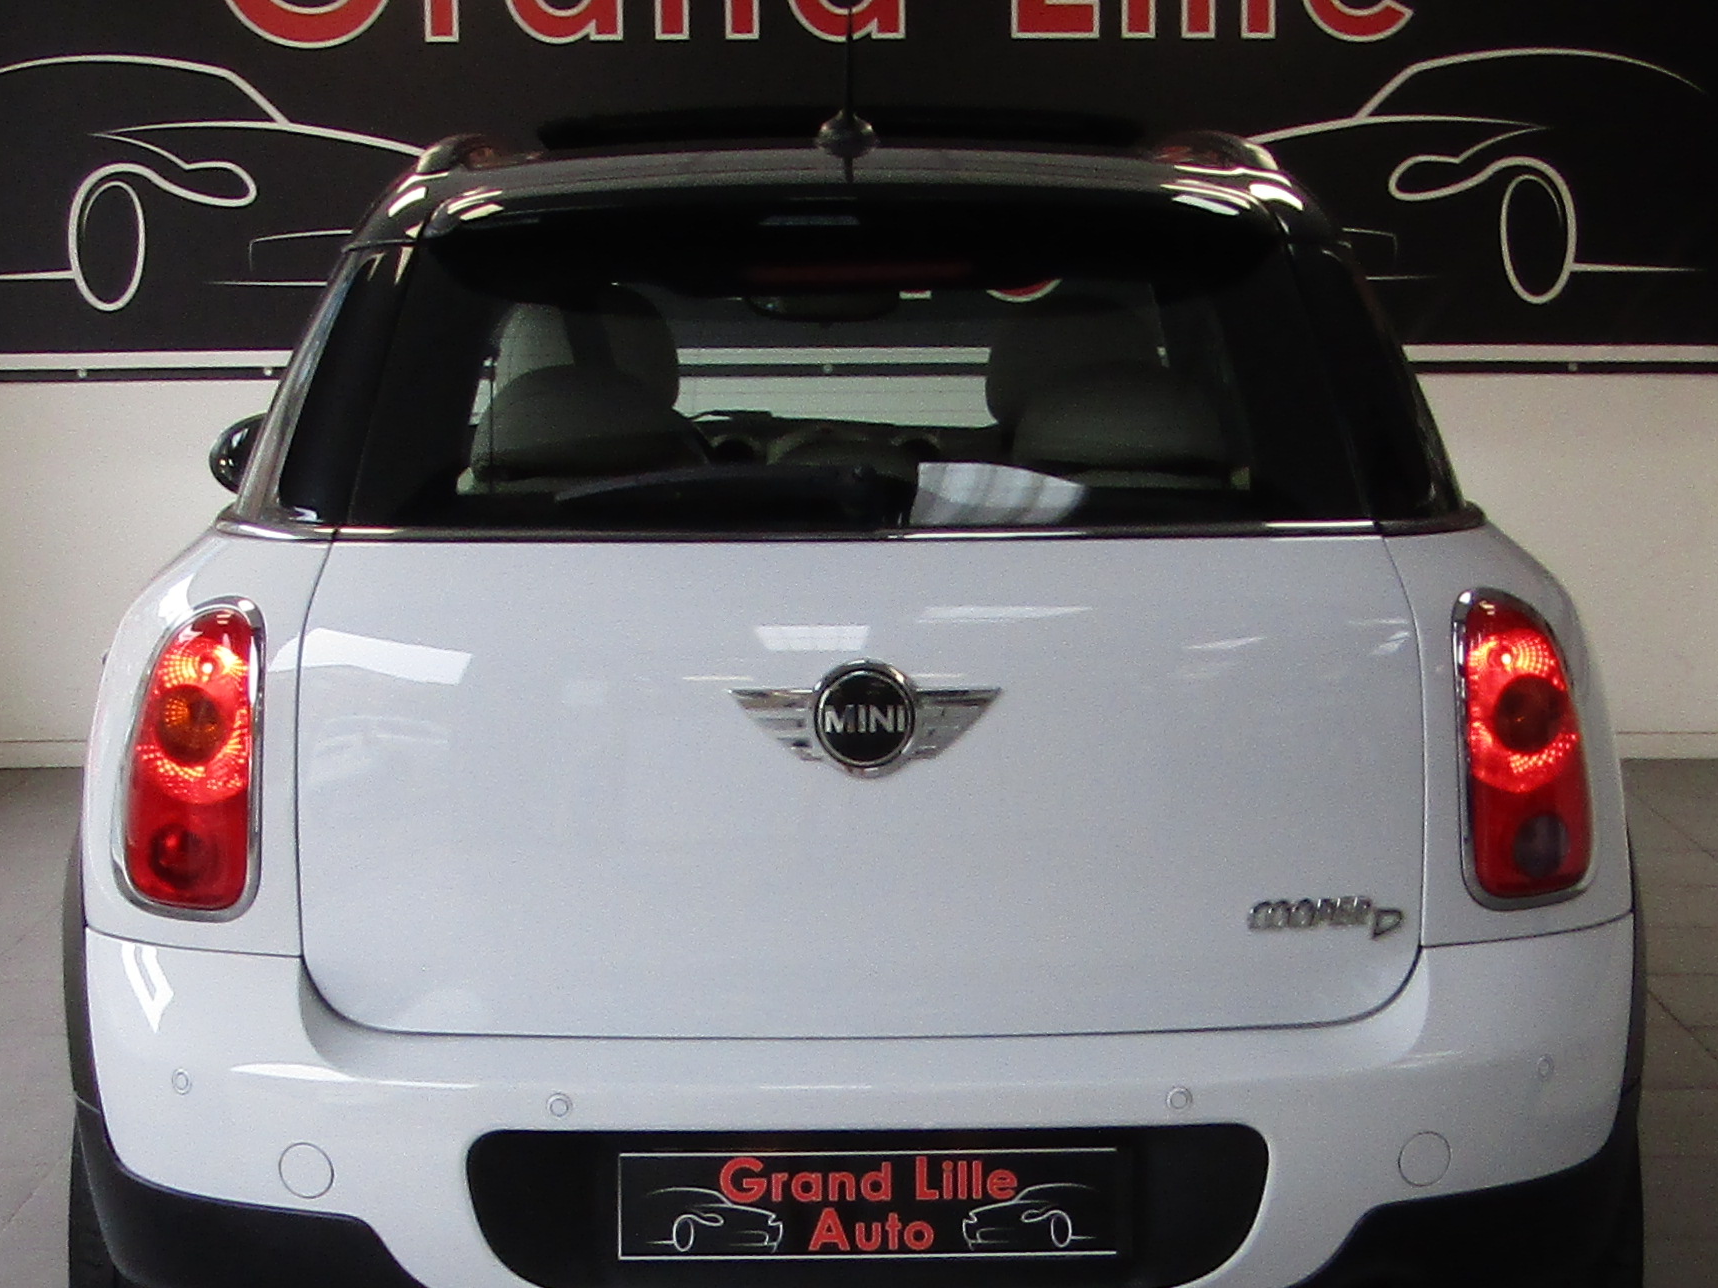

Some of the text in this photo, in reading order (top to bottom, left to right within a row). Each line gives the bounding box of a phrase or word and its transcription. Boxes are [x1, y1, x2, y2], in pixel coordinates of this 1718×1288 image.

[824, 704, 906, 735] MINI
[719, 1154, 1019, 1204] Grand Lille
[808, 1207, 935, 1252] Auto
